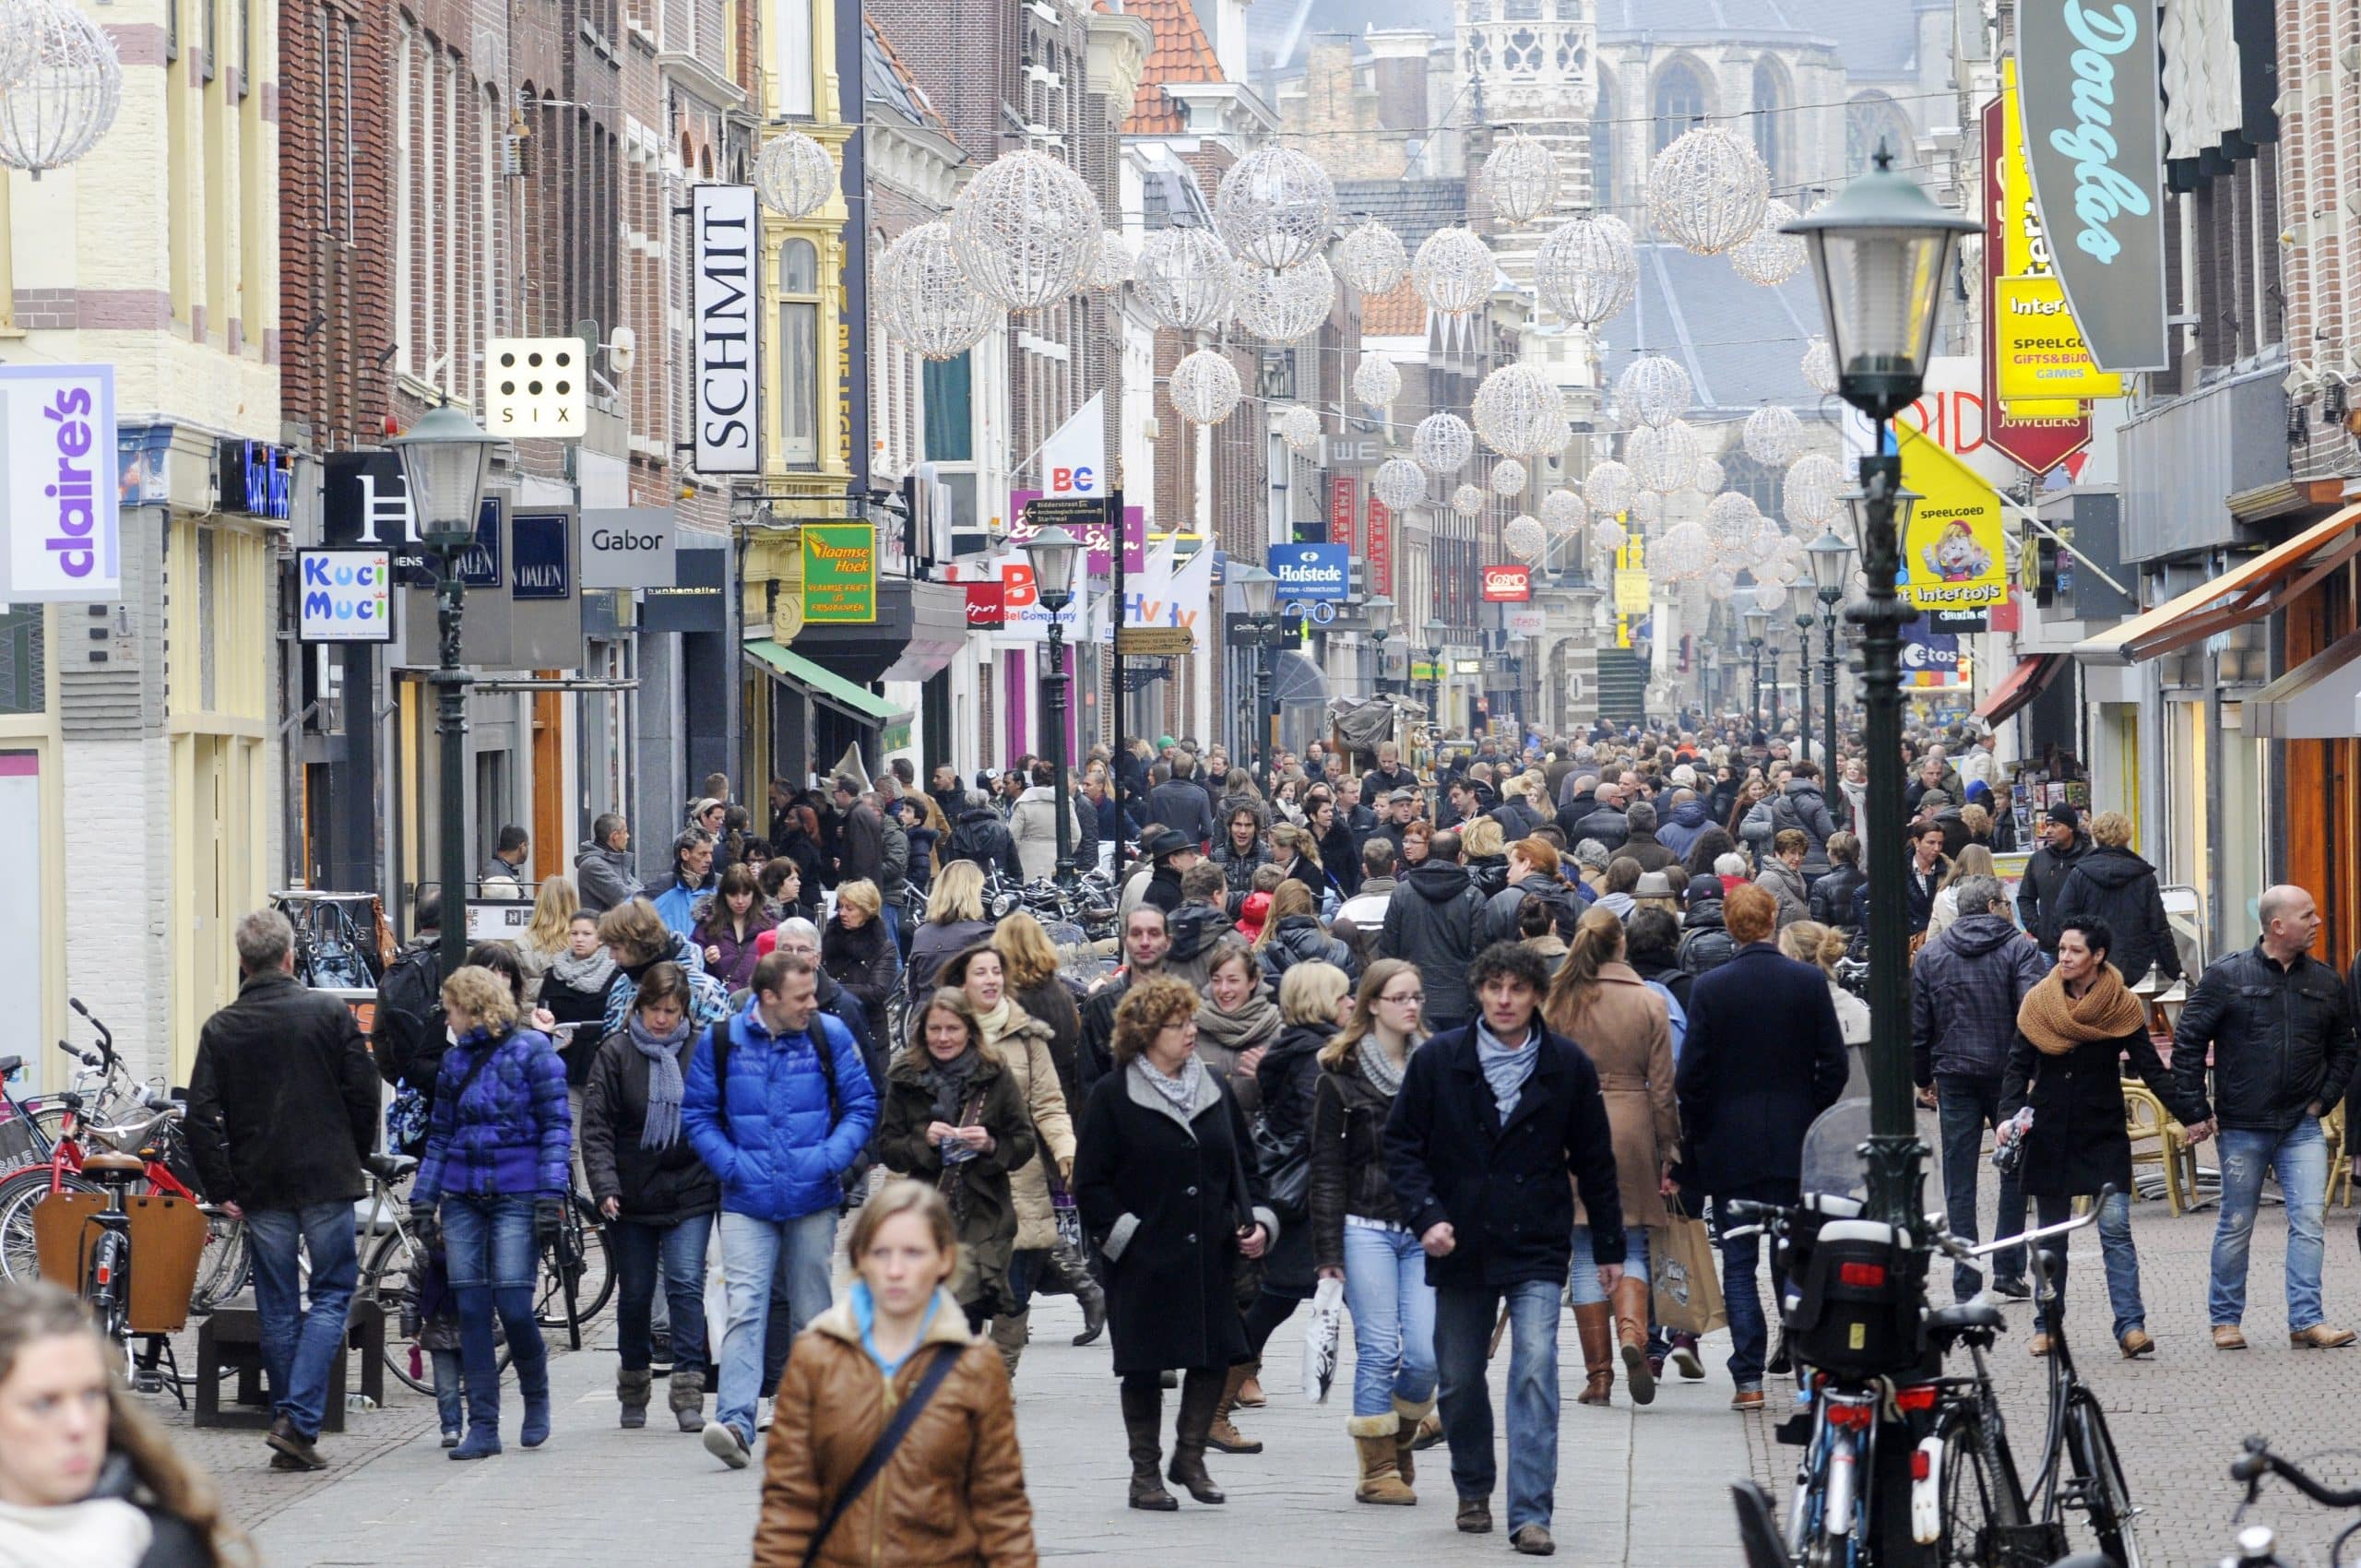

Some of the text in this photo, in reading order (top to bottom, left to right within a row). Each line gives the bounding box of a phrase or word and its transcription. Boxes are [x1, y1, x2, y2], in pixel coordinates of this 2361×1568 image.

[2049, 0, 2151, 265] Douglas
[704, 206, 748, 448] SCHMIT
[503, 408, 569, 422] SIX
[1334, 441, 1378, 460] WE
[44, 387, 94, 577] claire's
[1052, 467, 1094, 492] BC
[592, 529, 663, 551] Gabor
[304, 557, 386, 586] Kuci
[456, 552, 493, 575] ALEN
[835, 559, 870, 573] Hoek
[1278, 564, 1342, 582] Hofstede
[1918, 585, 2000, 602] Intertoys
[304, 591, 386, 620] Muci
[1003, 611, 1077, 623] BelCompany
[1456, 661, 1479, 672] WE
